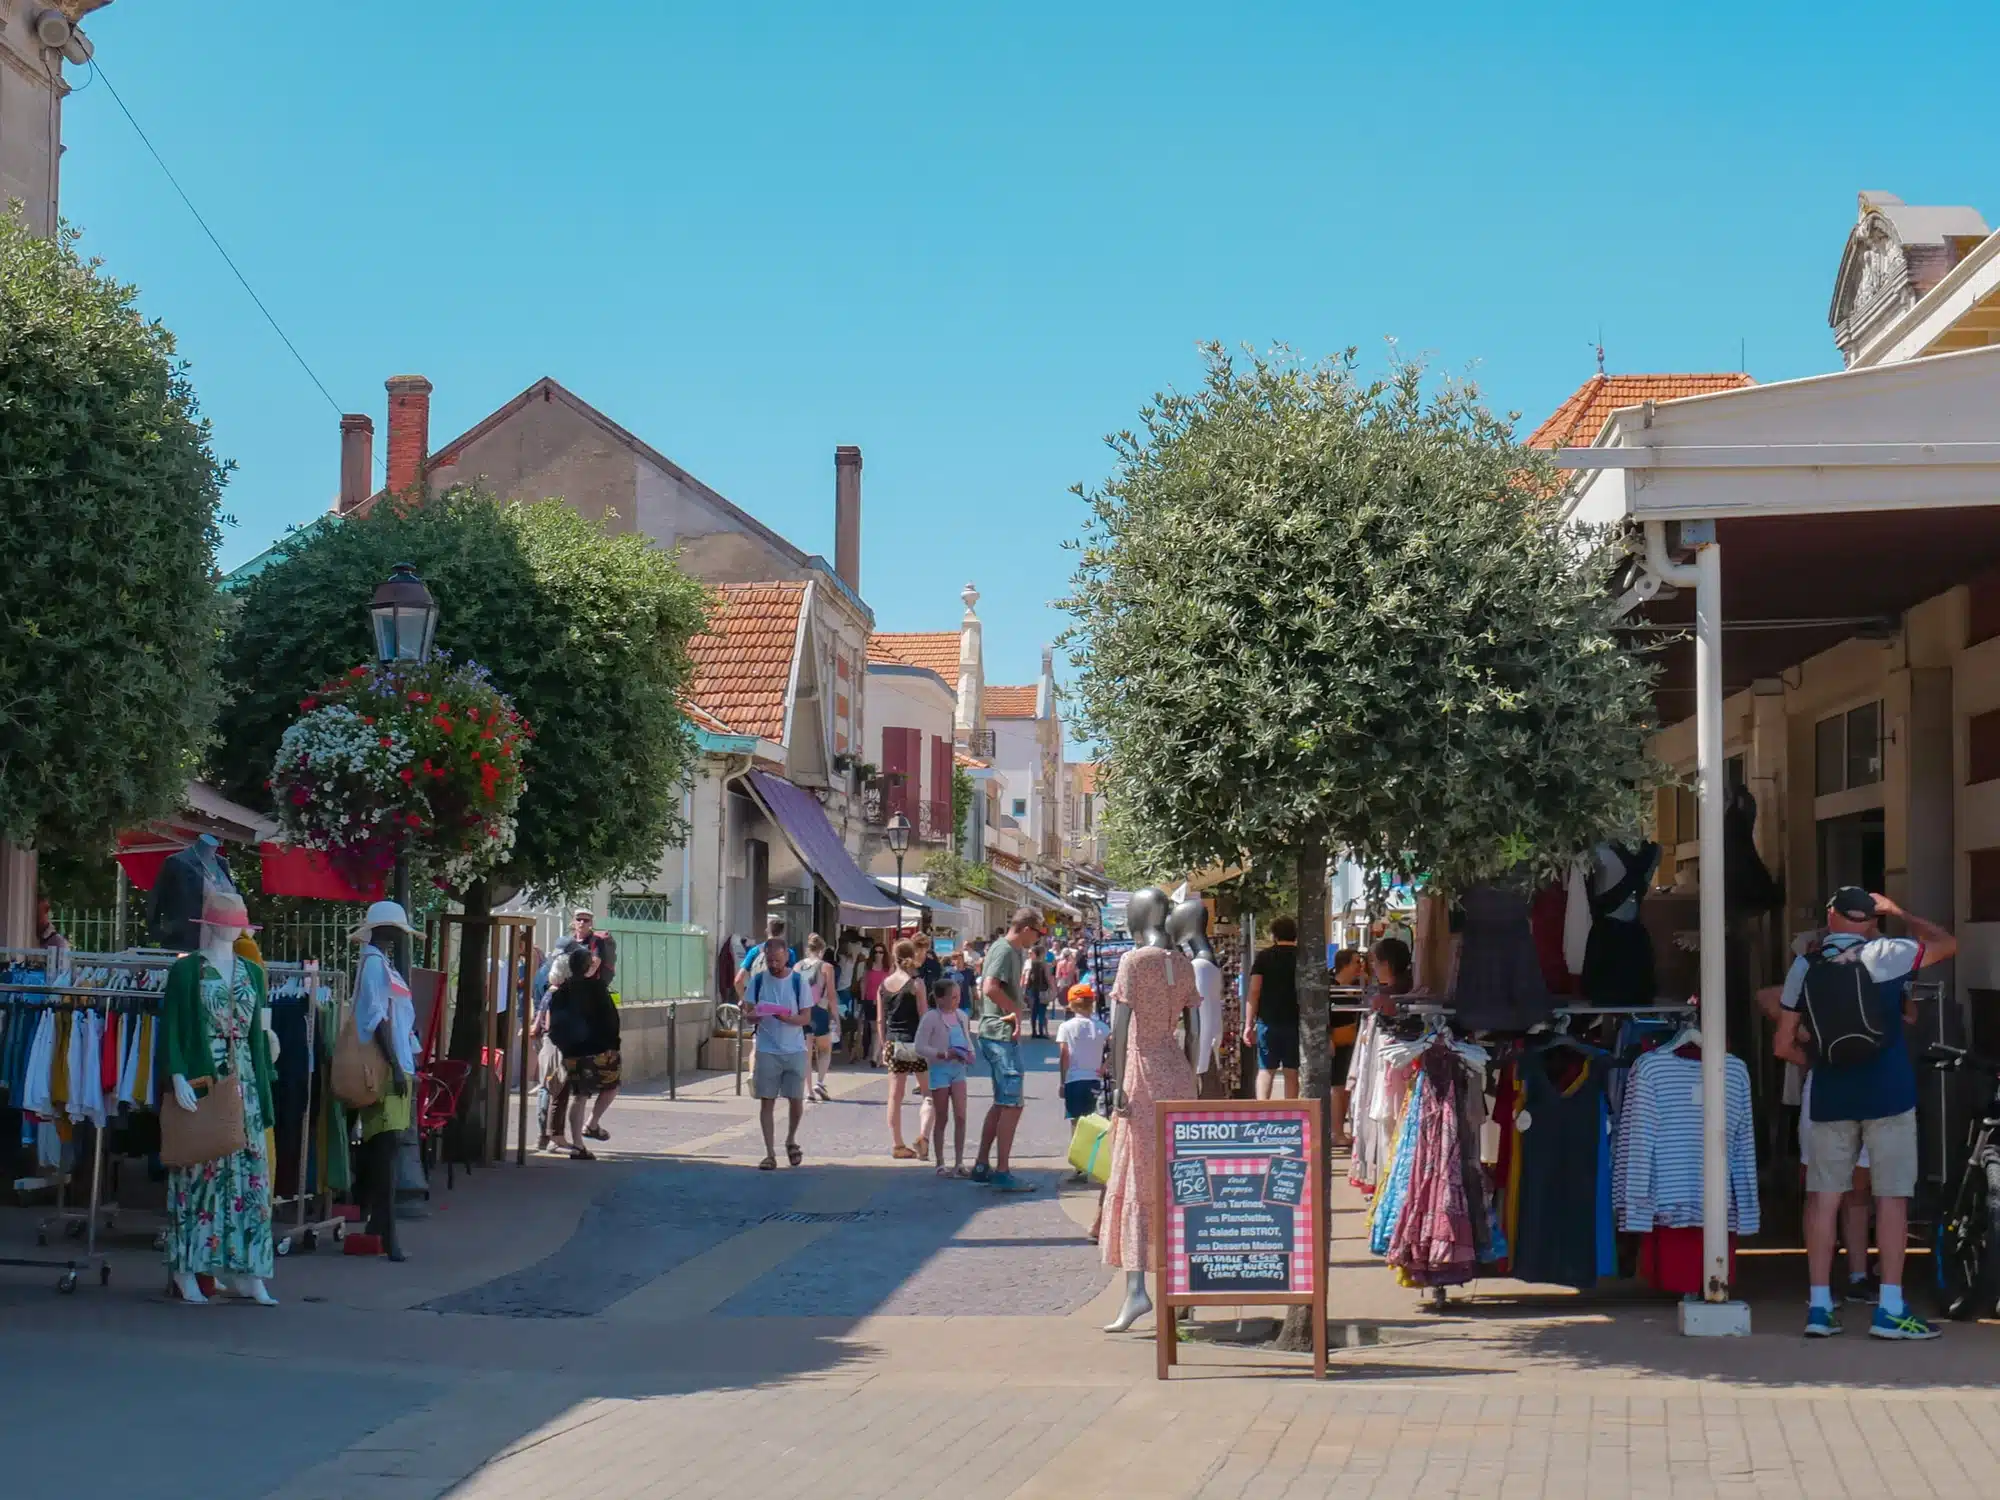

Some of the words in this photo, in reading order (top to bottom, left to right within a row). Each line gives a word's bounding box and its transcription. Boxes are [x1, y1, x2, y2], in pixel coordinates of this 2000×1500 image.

[1175, 1124, 1238, 1140] BISTROT
[1240, 1122, 1300, 1137] Tartines
[1175, 1176, 1207, 1196] 15€
[1210, 1228, 1239, 1237] Salade
[1241, 1227, 1282, 1238] BISTROT,
[1212, 1242, 1251, 1251] Desserts
[1252, 1241, 1284, 1250] Maison
